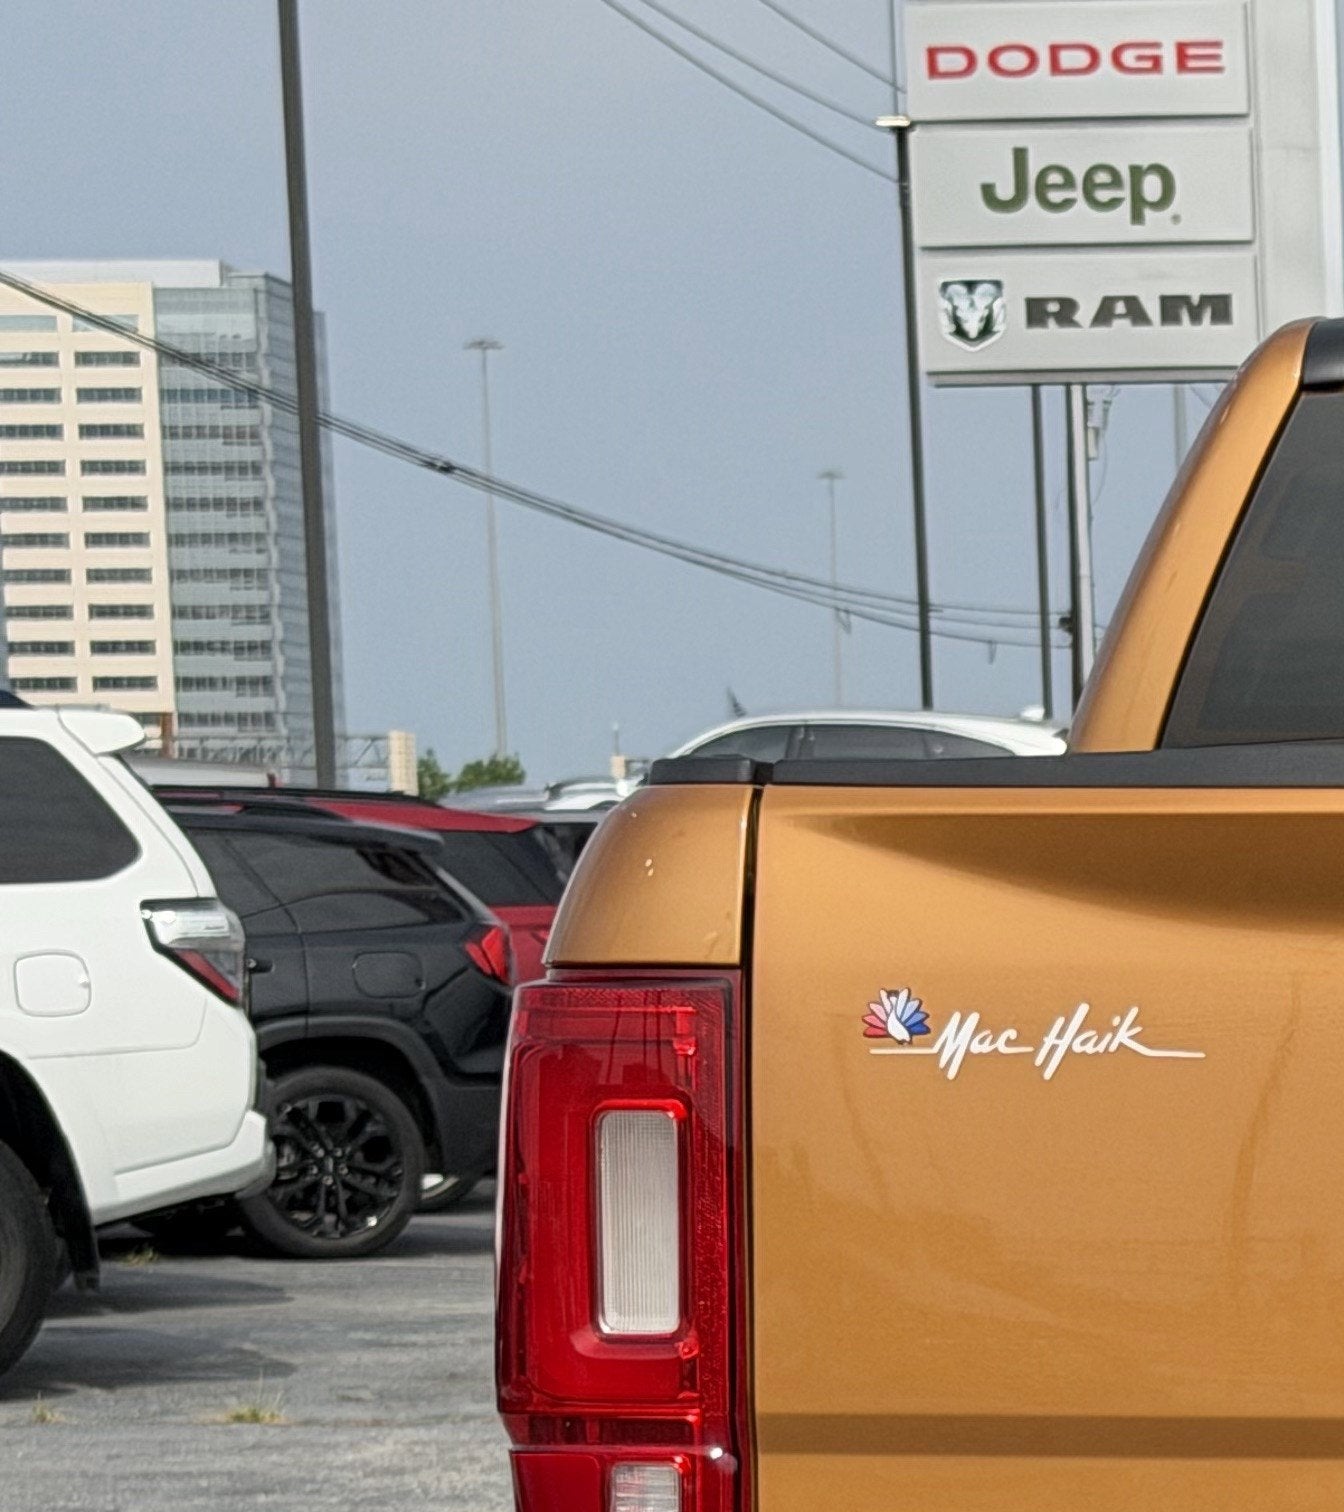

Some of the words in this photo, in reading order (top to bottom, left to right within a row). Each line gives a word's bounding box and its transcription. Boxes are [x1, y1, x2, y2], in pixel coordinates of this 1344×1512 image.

[926, 40, 1226, 80] DODGE
[980, 146, 1177, 226] Jeep
[1023, 293, 1234, 330] RAM
[928, 1010, 1034, 1081] Mac
[1034, 1002, 1206, 1081] Haik
